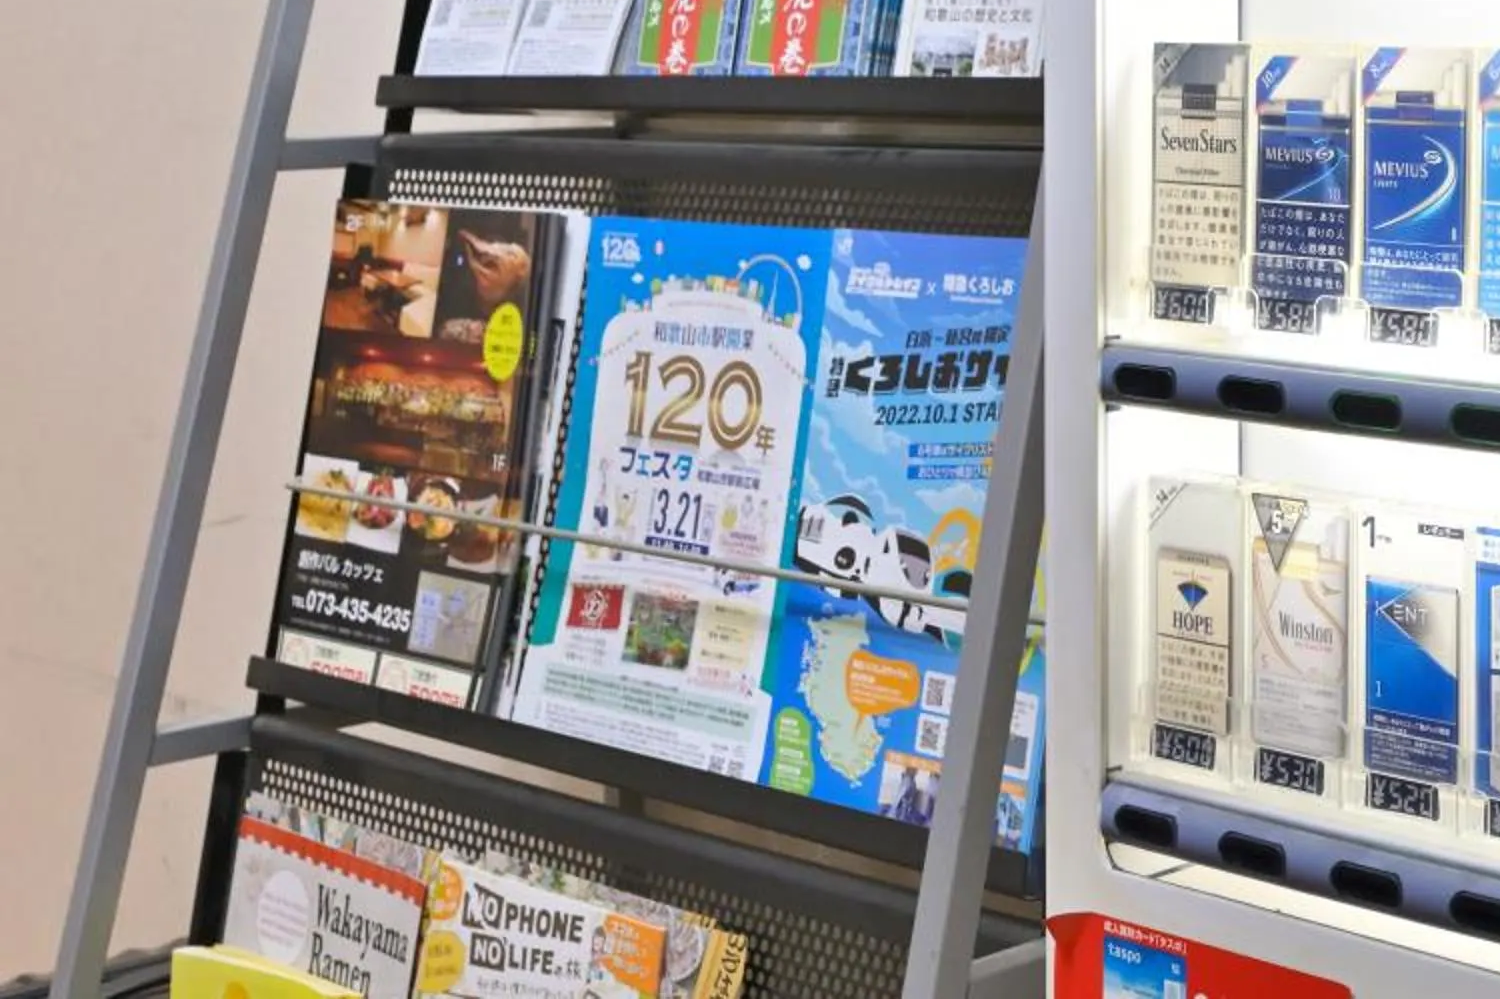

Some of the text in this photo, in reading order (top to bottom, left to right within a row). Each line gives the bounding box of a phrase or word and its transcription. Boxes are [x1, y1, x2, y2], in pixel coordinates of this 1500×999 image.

[1264, 146, 1314, 165] MEVIUS
[1373, 160, 1429, 179] MEVIUS
[624, 350, 763, 452] 120
[874, 400, 1003, 427] 2022.10.1 STA
[619, 446, 694, 481] フェスタ
[652, 487, 702, 541] 3.21
[305, 589, 412, 633] 073-435-4235
[1172, 610, 1214, 636] HOPE
[1278, 610, 1334, 644] Winston
[316, 883, 410, 965] Wakayama
[466, 884, 586, 944] NO PHONE
[307, 931, 372, 998] Ramen
[473, 936, 553, 975] NO LIFE
[1107, 941, 1142, 965] taspo
